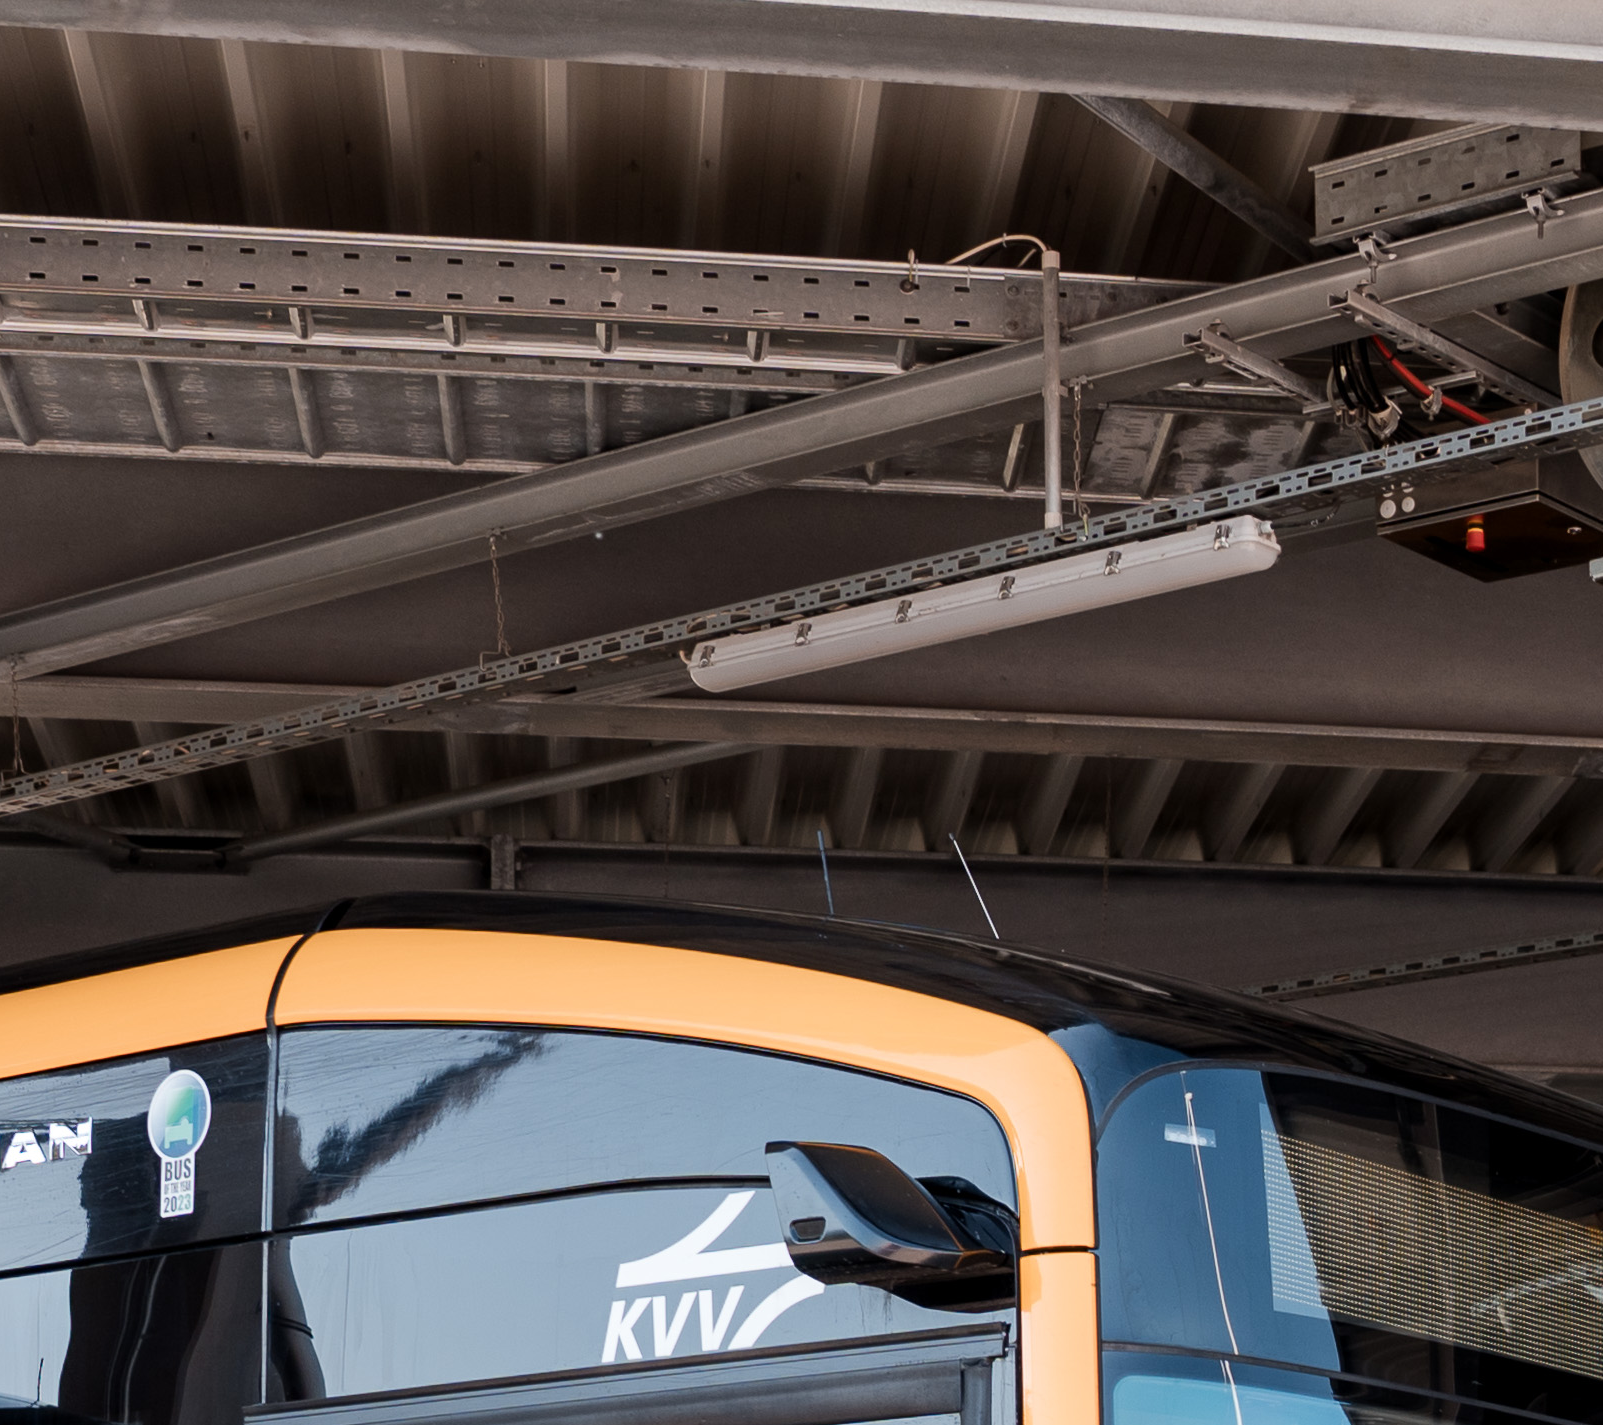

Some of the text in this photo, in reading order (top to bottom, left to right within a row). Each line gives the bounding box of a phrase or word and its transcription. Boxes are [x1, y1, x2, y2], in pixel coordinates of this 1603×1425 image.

[164, 1158, 191, 1182] BUS
[164, 1193, 192, 1213] 2023
[601, 1285, 745, 1363] KVV
